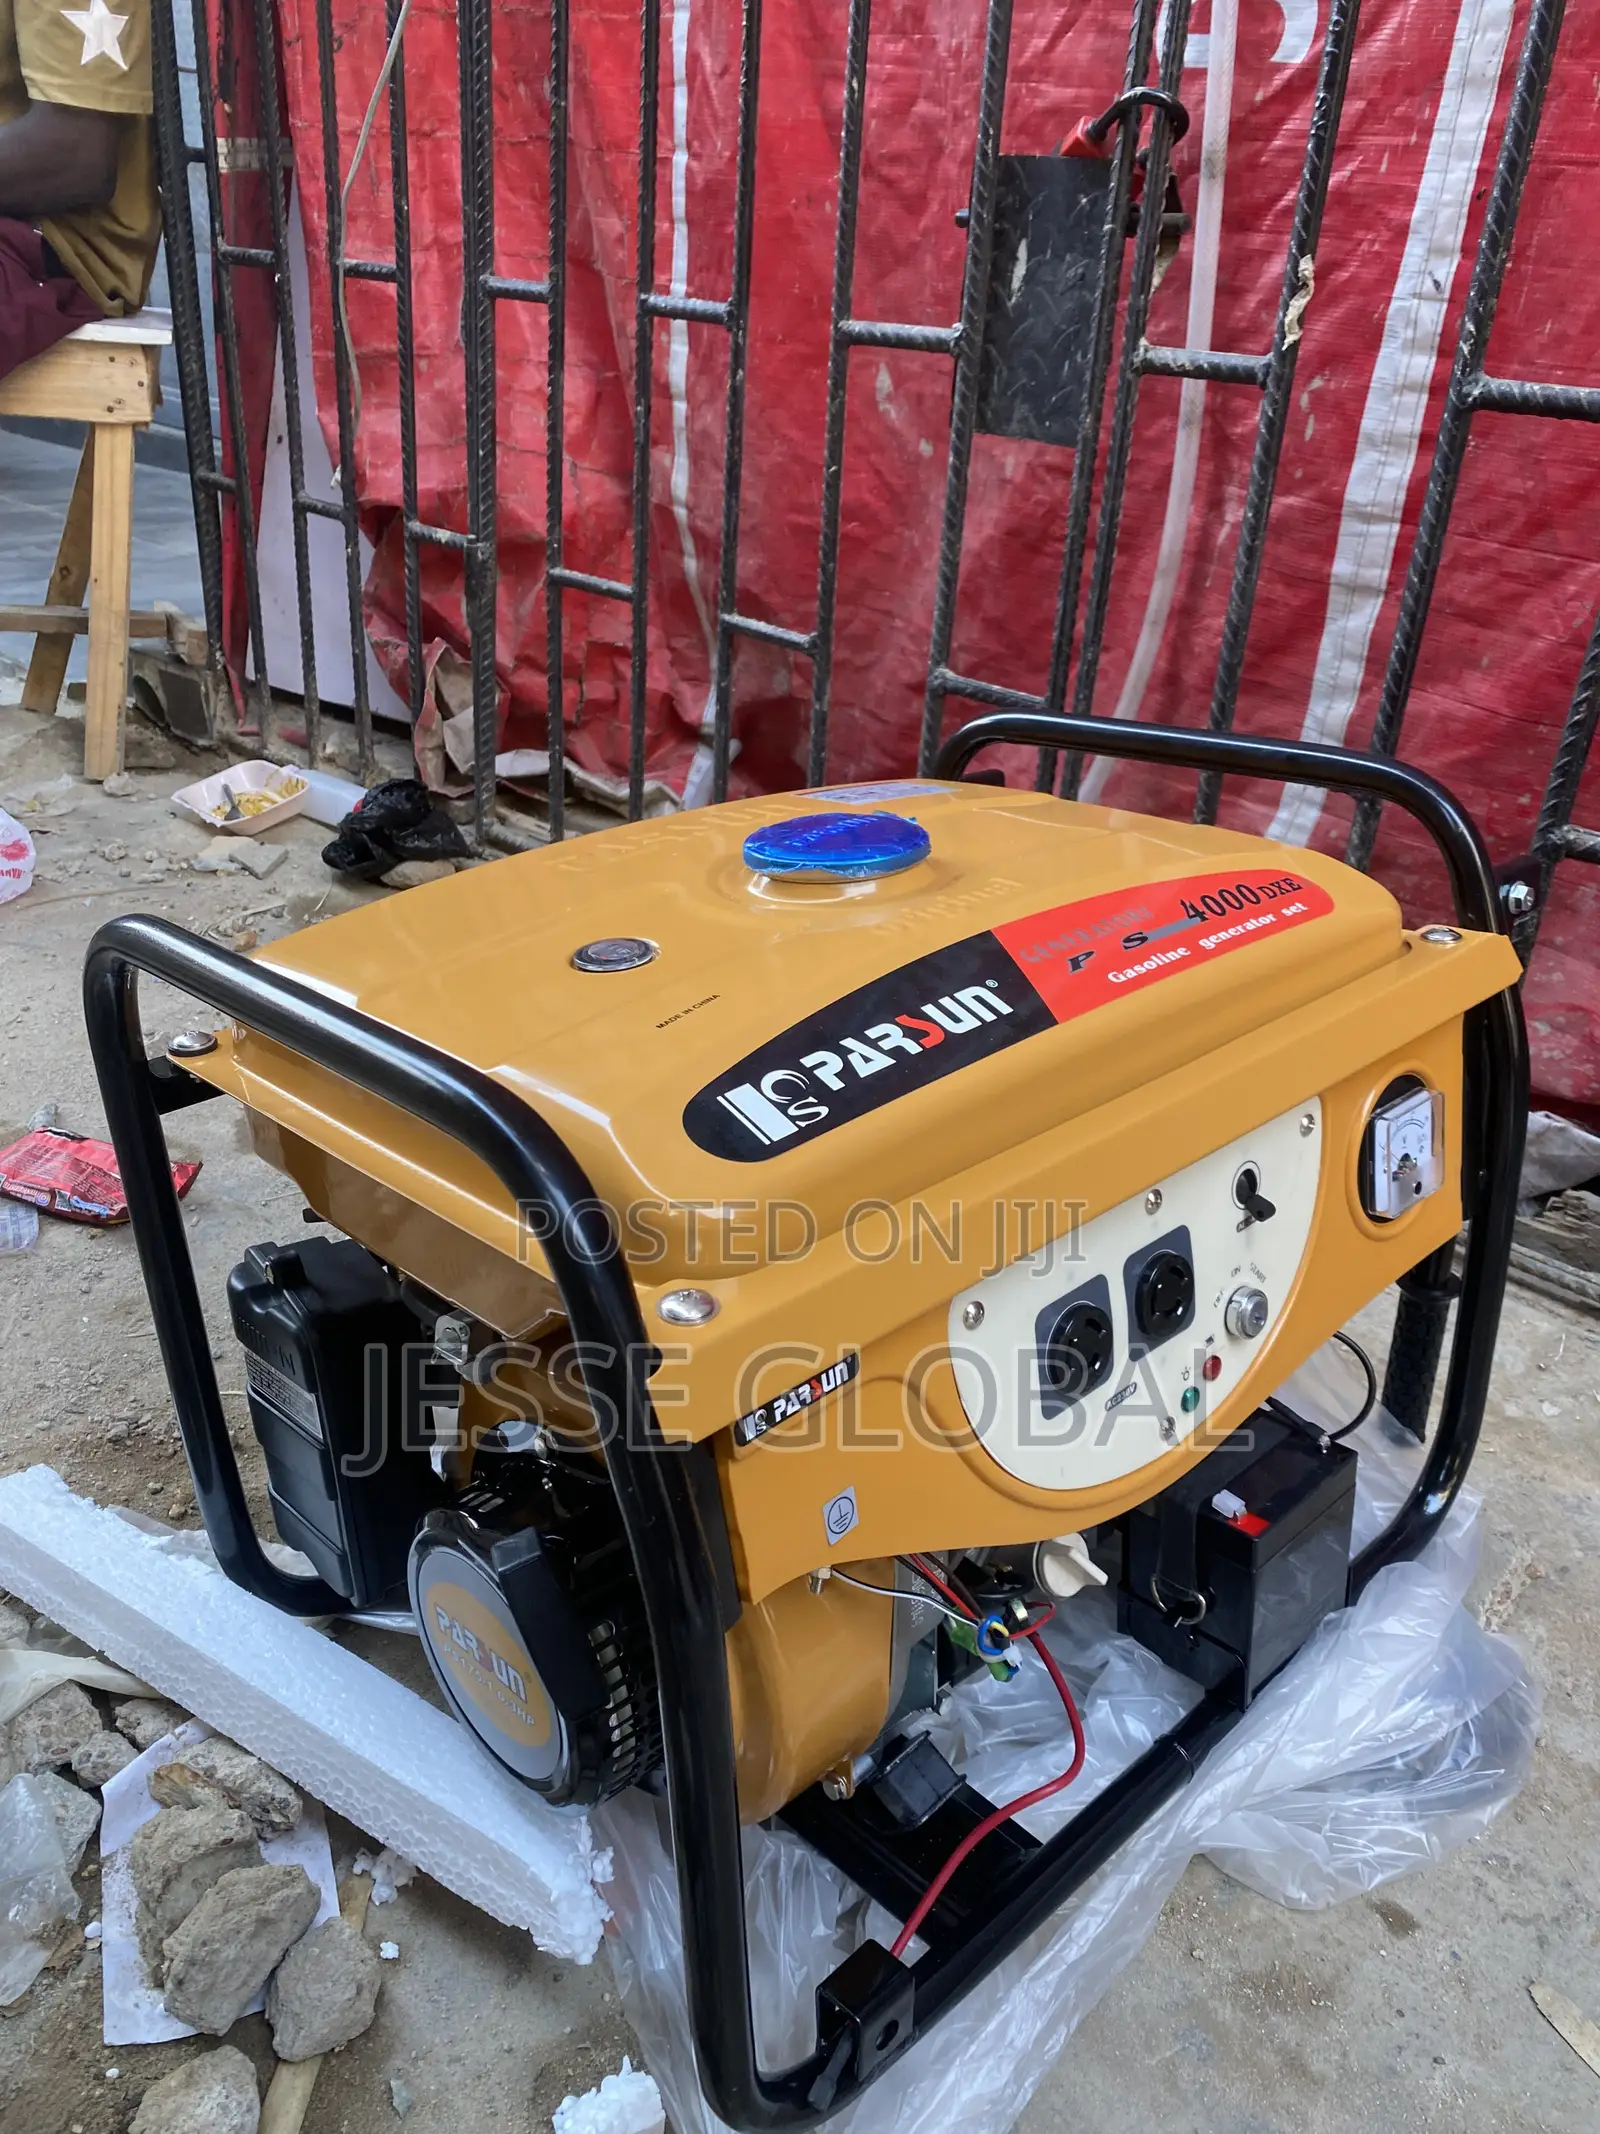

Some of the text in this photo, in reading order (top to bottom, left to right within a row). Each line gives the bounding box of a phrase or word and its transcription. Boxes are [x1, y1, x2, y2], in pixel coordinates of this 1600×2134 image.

[1108, 901, 1309, 983] Gasoline generator set
[655, 994, 720, 1028] MADE IN CHINA
[1231, 1266, 1241, 1278] ON
[1250, 1262, 1266, 1283] START
